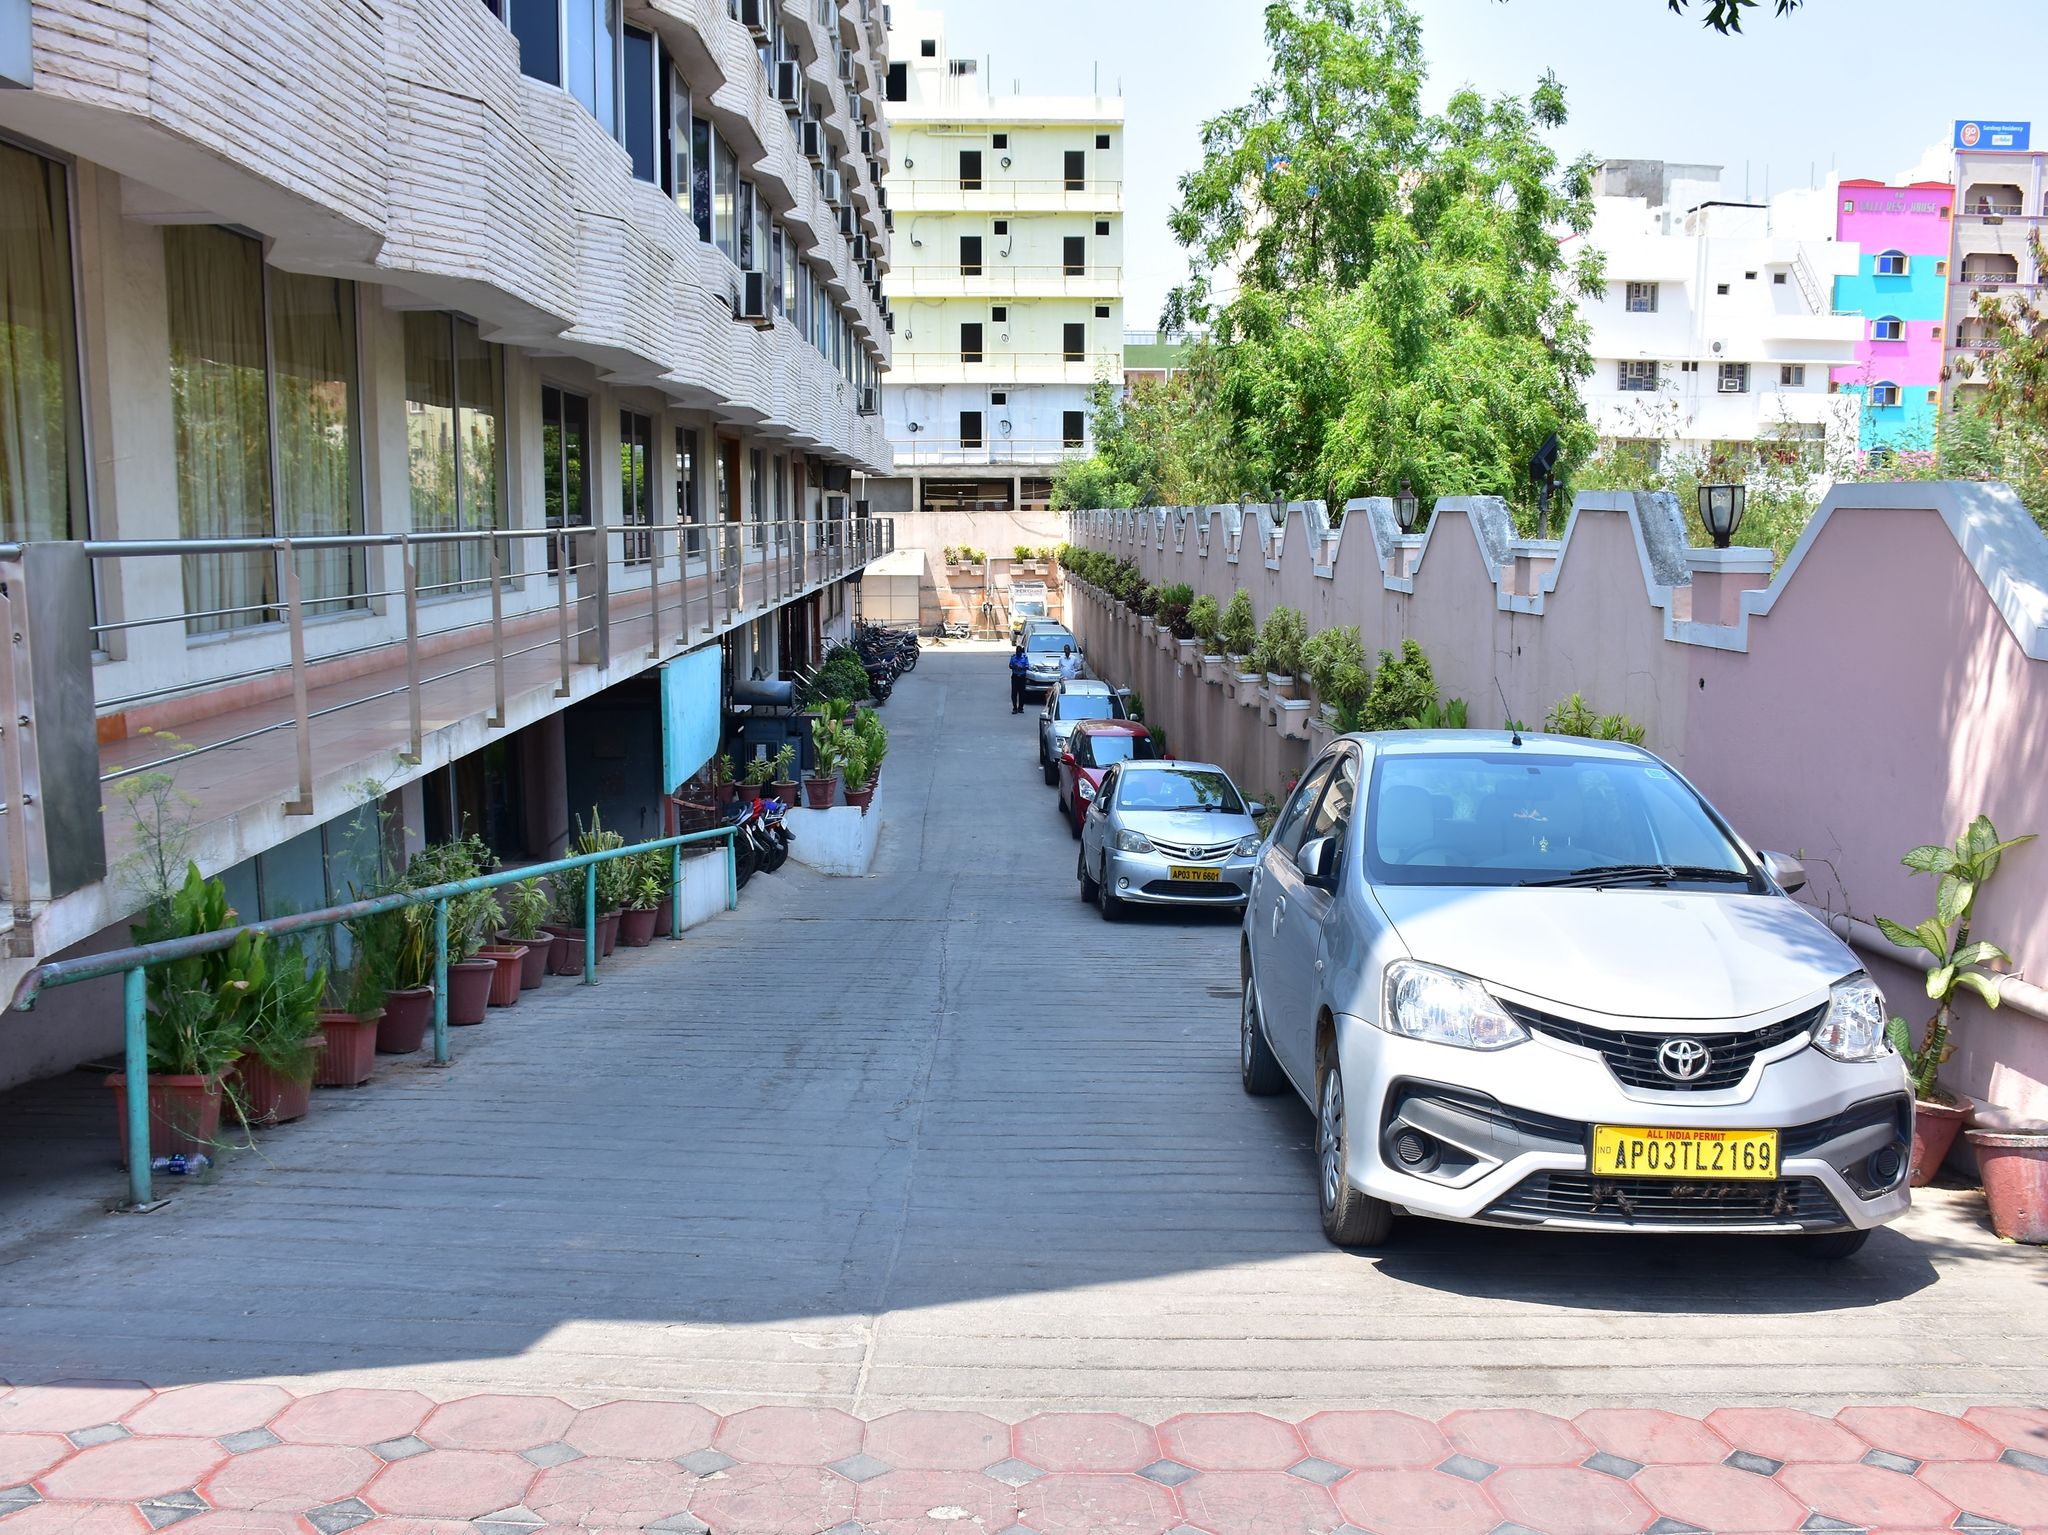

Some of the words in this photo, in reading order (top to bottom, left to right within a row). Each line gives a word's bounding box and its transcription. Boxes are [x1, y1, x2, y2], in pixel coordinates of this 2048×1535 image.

[1911, 202, 1937, 213] HOUSE
[1173, 870, 1190, 879] AP03
[1191, 871, 1202, 880] TV
[1647, 1129, 1664, 1139] ALL
[1666, 1130, 1691, 1140] INDIA
[1693, 1130, 1727, 1141] PERMIT
[1597, 1145, 1612, 1155] IND
[1615, 1139, 1771, 1171] AP03TL2169
